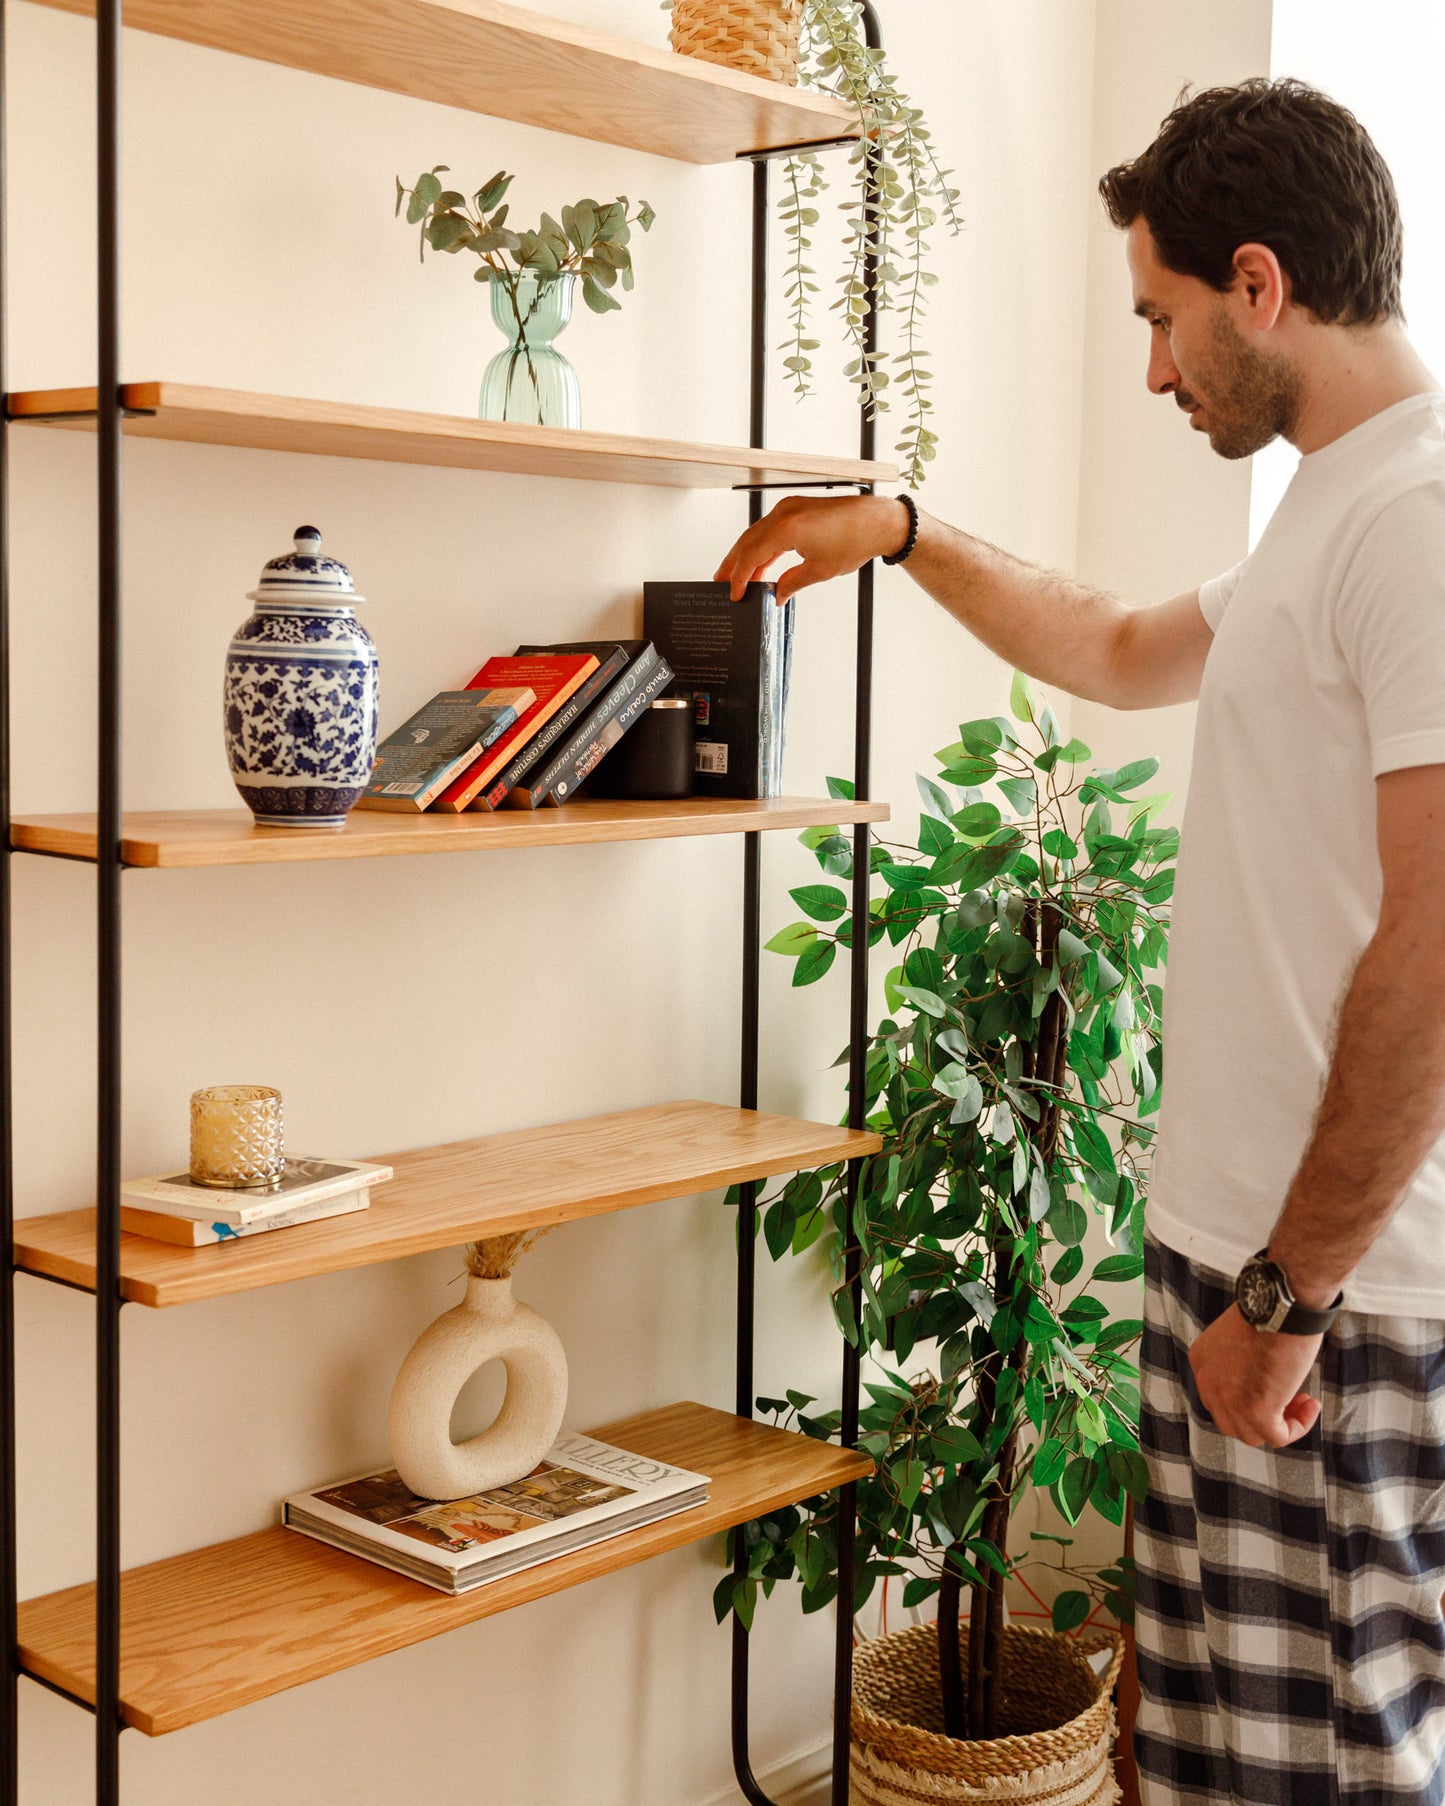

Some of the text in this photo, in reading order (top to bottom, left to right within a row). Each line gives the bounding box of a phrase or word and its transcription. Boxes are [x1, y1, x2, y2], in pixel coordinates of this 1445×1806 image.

[633, 653, 654, 675] Ann
[595, 674, 639, 722] Cleeves
[618, 666, 670, 724] Paulo Coelho
[508, 703, 578, 782] HARLEQUIN'S COSTUME
[544, 721, 597, 784] HIDDEN DEPTHS
[592, 744, 607, 759] The
[554, 1437, 686, 1483] ALLERY
